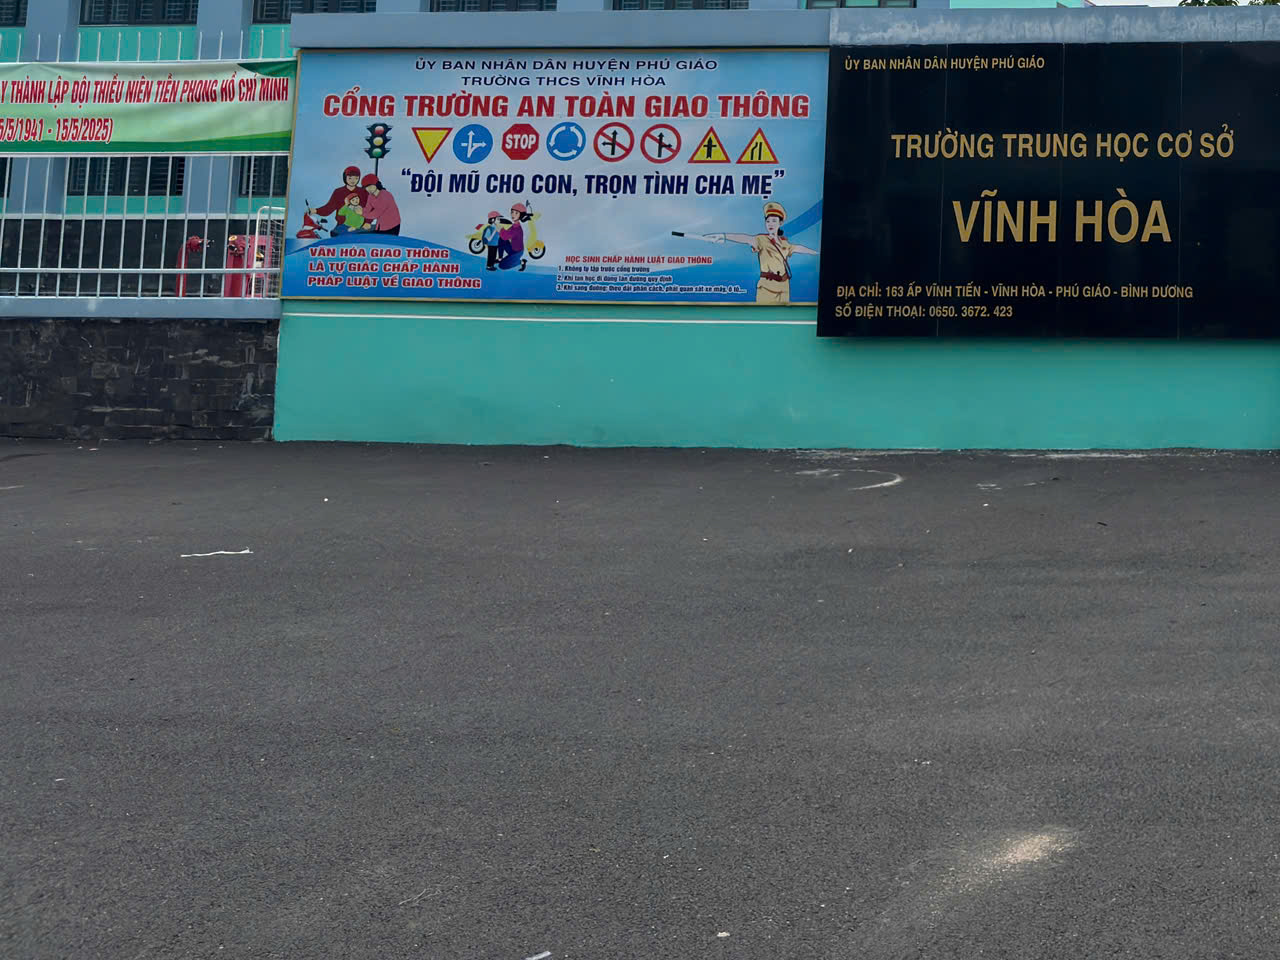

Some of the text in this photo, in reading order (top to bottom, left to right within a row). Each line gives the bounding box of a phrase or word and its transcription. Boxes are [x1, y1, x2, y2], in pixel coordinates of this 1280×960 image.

[415, 58, 717, 72] ỦY BAN NHÂN DÂN HUYỆN PHÚ GIÁO
[845, 55, 1045, 71] ỦY BAN NHÂN DÂN HUYỆN PHÚ GIÁO
[462, 74, 666, 86] TRƯỜNG THCS VĨNH HÒA
[10, 75, 46, 103] THÀNH
[47, 75, 70, 109] LẬP
[70, 75, 91, 109] ĐỘI
[92, 73, 125, 103] THIẾU
[125, 75, 154, 103] NIÊN
[180, 79, 218, 103] PHONG
[238, 73, 257, 102] CHÍ
[258, 78, 289, 101] MINH
[323, 87, 810, 118] CỔNG TRƯỜNG AN TOÀN GIAO THÔNG
[56, 117, 114, 144] 15/5/2025)
[504, 133, 537, 150] STOP
[891, 123, 1234, 162] TRƯỜNG TRUNG HỌC CƠ SỞ
[449, 170, 480, 193] MŨ
[486, 173, 525, 194] CHO
[531, 174, 577, 196] CON,
[584, 174, 637, 199] TRỌN
[643, 171, 689, 195] TÌNH
[695, 174, 734, 195] CHA
[952, 188, 1172, 243] VĨNH HÒA
[309, 247, 449, 258] VĂN HÓA GIAO THÔNG
[309, 260, 460, 273] LÀ TỰ GIÁC CHẤP HÀNH
[308, 276, 343, 286] PHÁP
[346, 276, 378, 288] LUẬT
[402, 278, 433, 288] GIAO
[437, 277, 481, 288] THÔNG
[836, 285, 856, 300] ĐỊA
[859, 282, 882, 297] CHỈ:
[885, 286, 904, 297] 163
[906, 281, 922, 297] ẤP
[925, 283, 952, 297] VĨNH
[955, 281, 981, 297] TIẾN
[991, 283, 1018, 297] VĨNH
[1022, 283, 1046, 297] HÒA
[1056, 283, 1079, 297] PHÚ
[1082, 283, 1111, 297] GIÁO
[1121, 283, 1149, 298] BÌNH
[1152, 284, 1193, 298] DƯƠNG
[835, 301, 1013, 319] SỐ ĐIỆN THOẠI: 0650. 3672. 423
